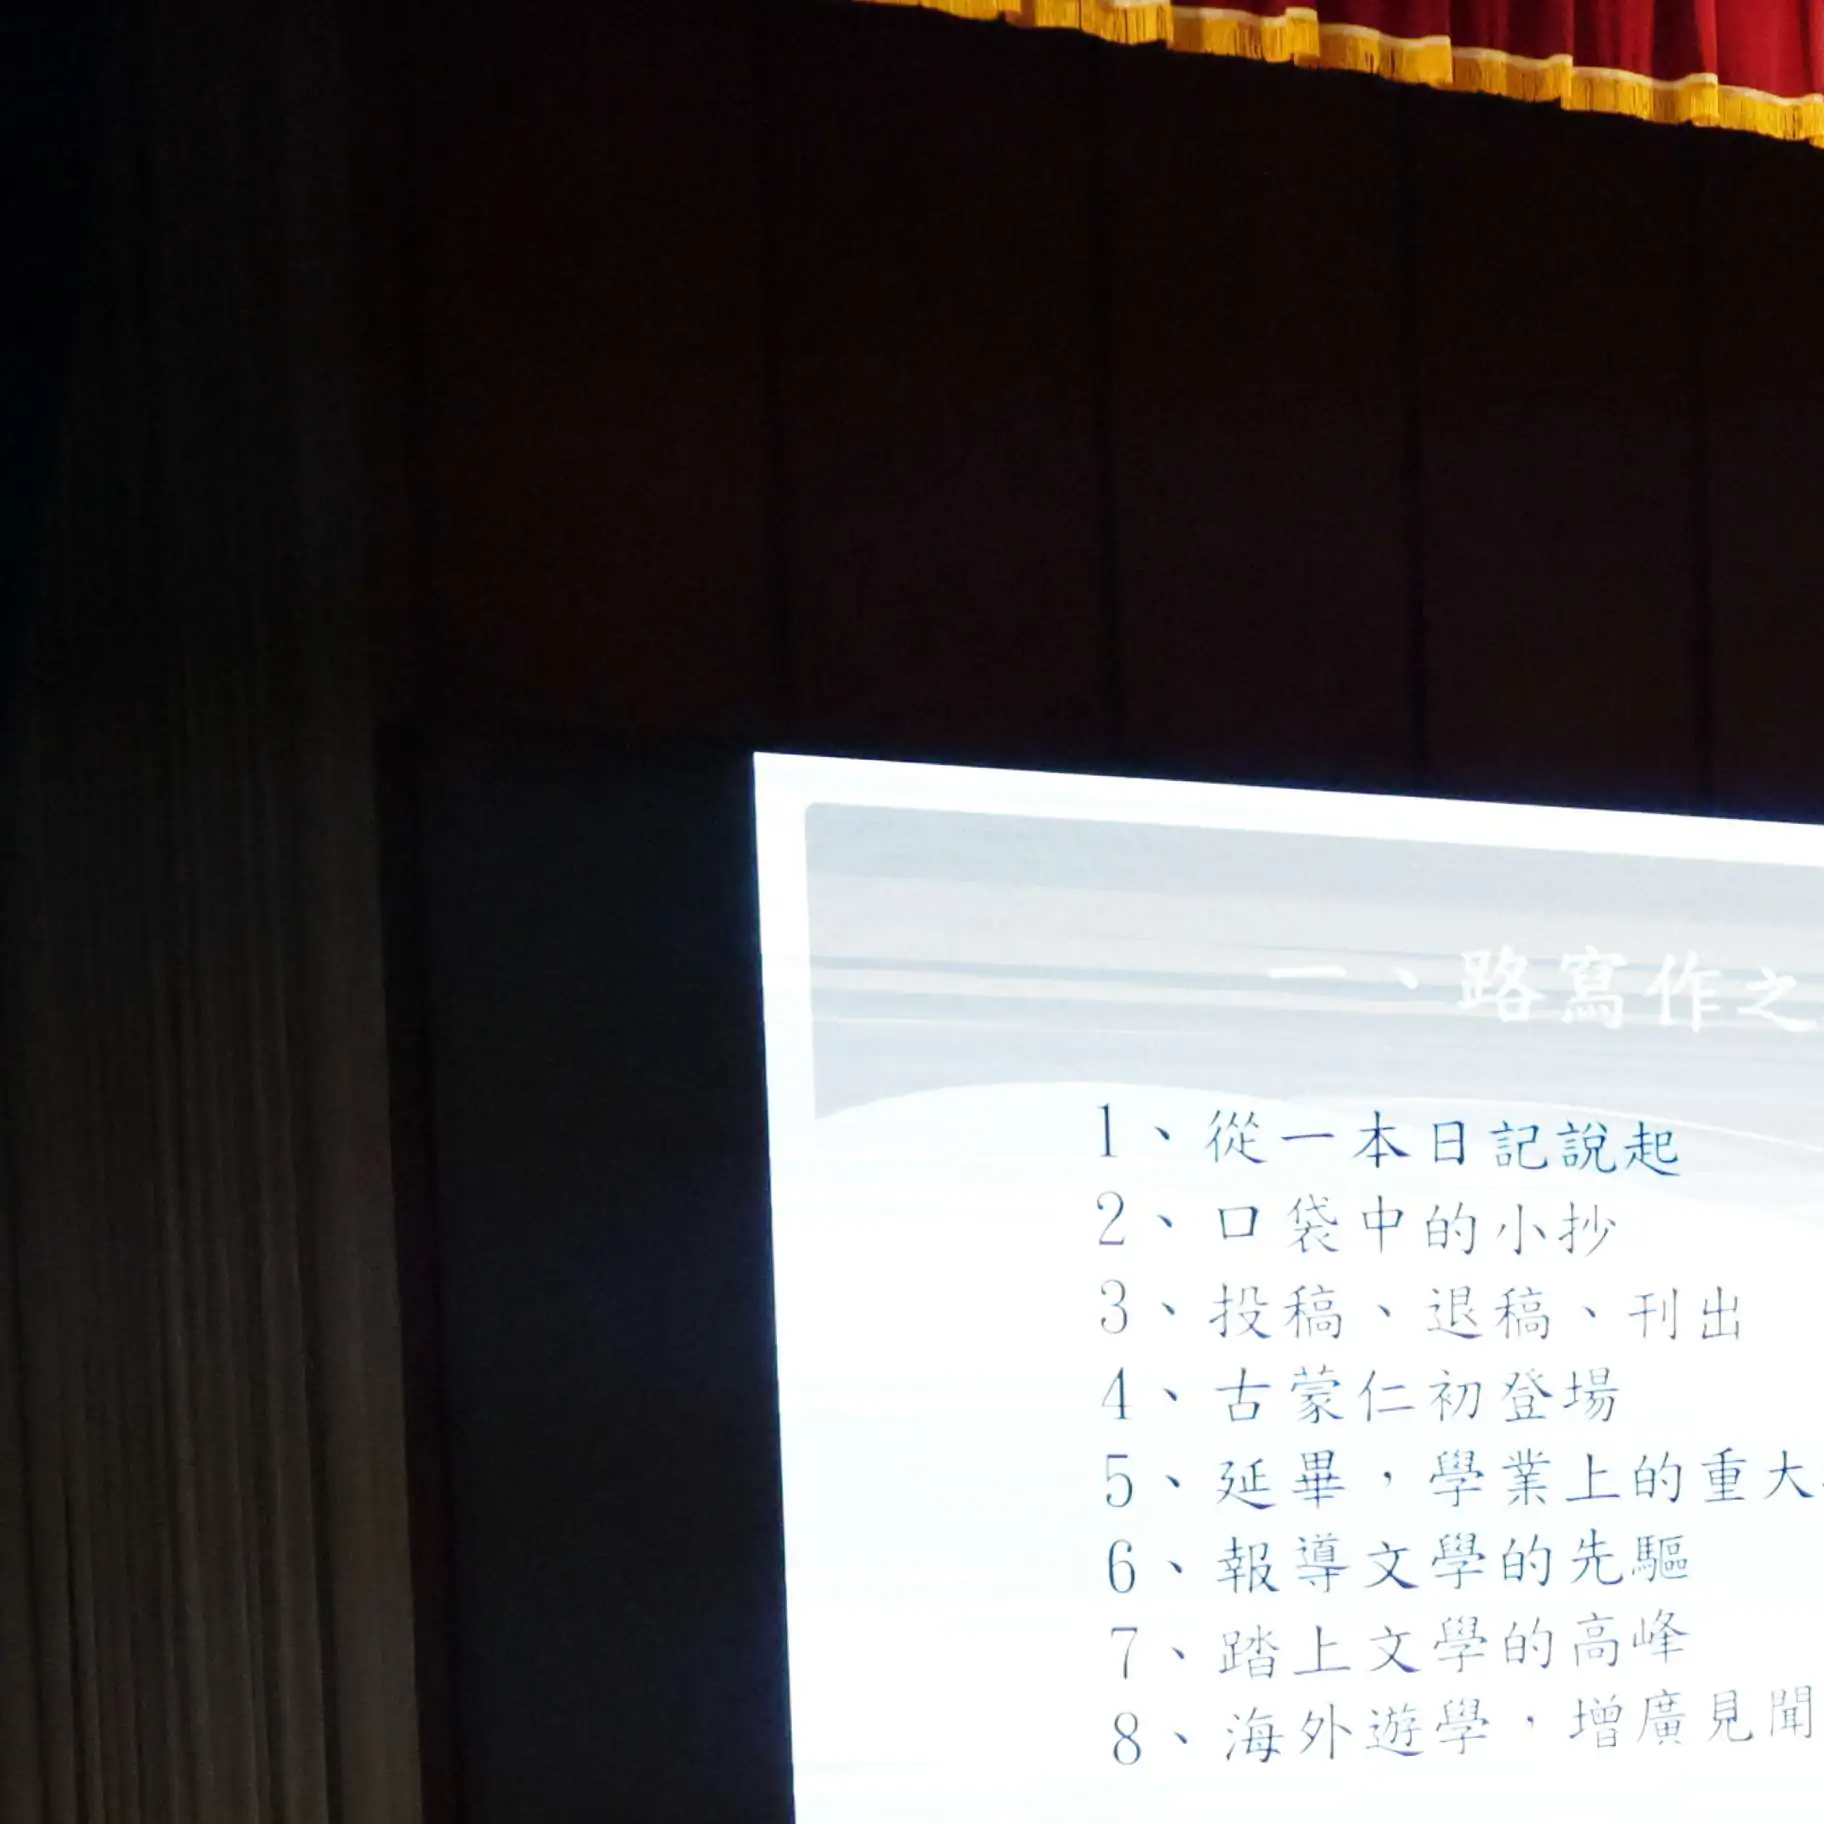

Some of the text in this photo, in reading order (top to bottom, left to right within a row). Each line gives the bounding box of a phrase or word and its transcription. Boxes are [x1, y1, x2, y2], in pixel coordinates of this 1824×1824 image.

[1096, 1102, 1682, 1177] 1、從一本日記說起
[1096, 1190, 1618, 1258] 2、口袋中的小抄
[1099, 1278, 1743, 1341] 3、投稿、退稿、刊出
[1101, 1363, 1621, 1426] 4、古蒙仁初登場
[1107, 1527, 1690, 1596] 6、報導文學的先驅
[1110, 1608, 1691, 1681] 7、踏上文學的高峰
